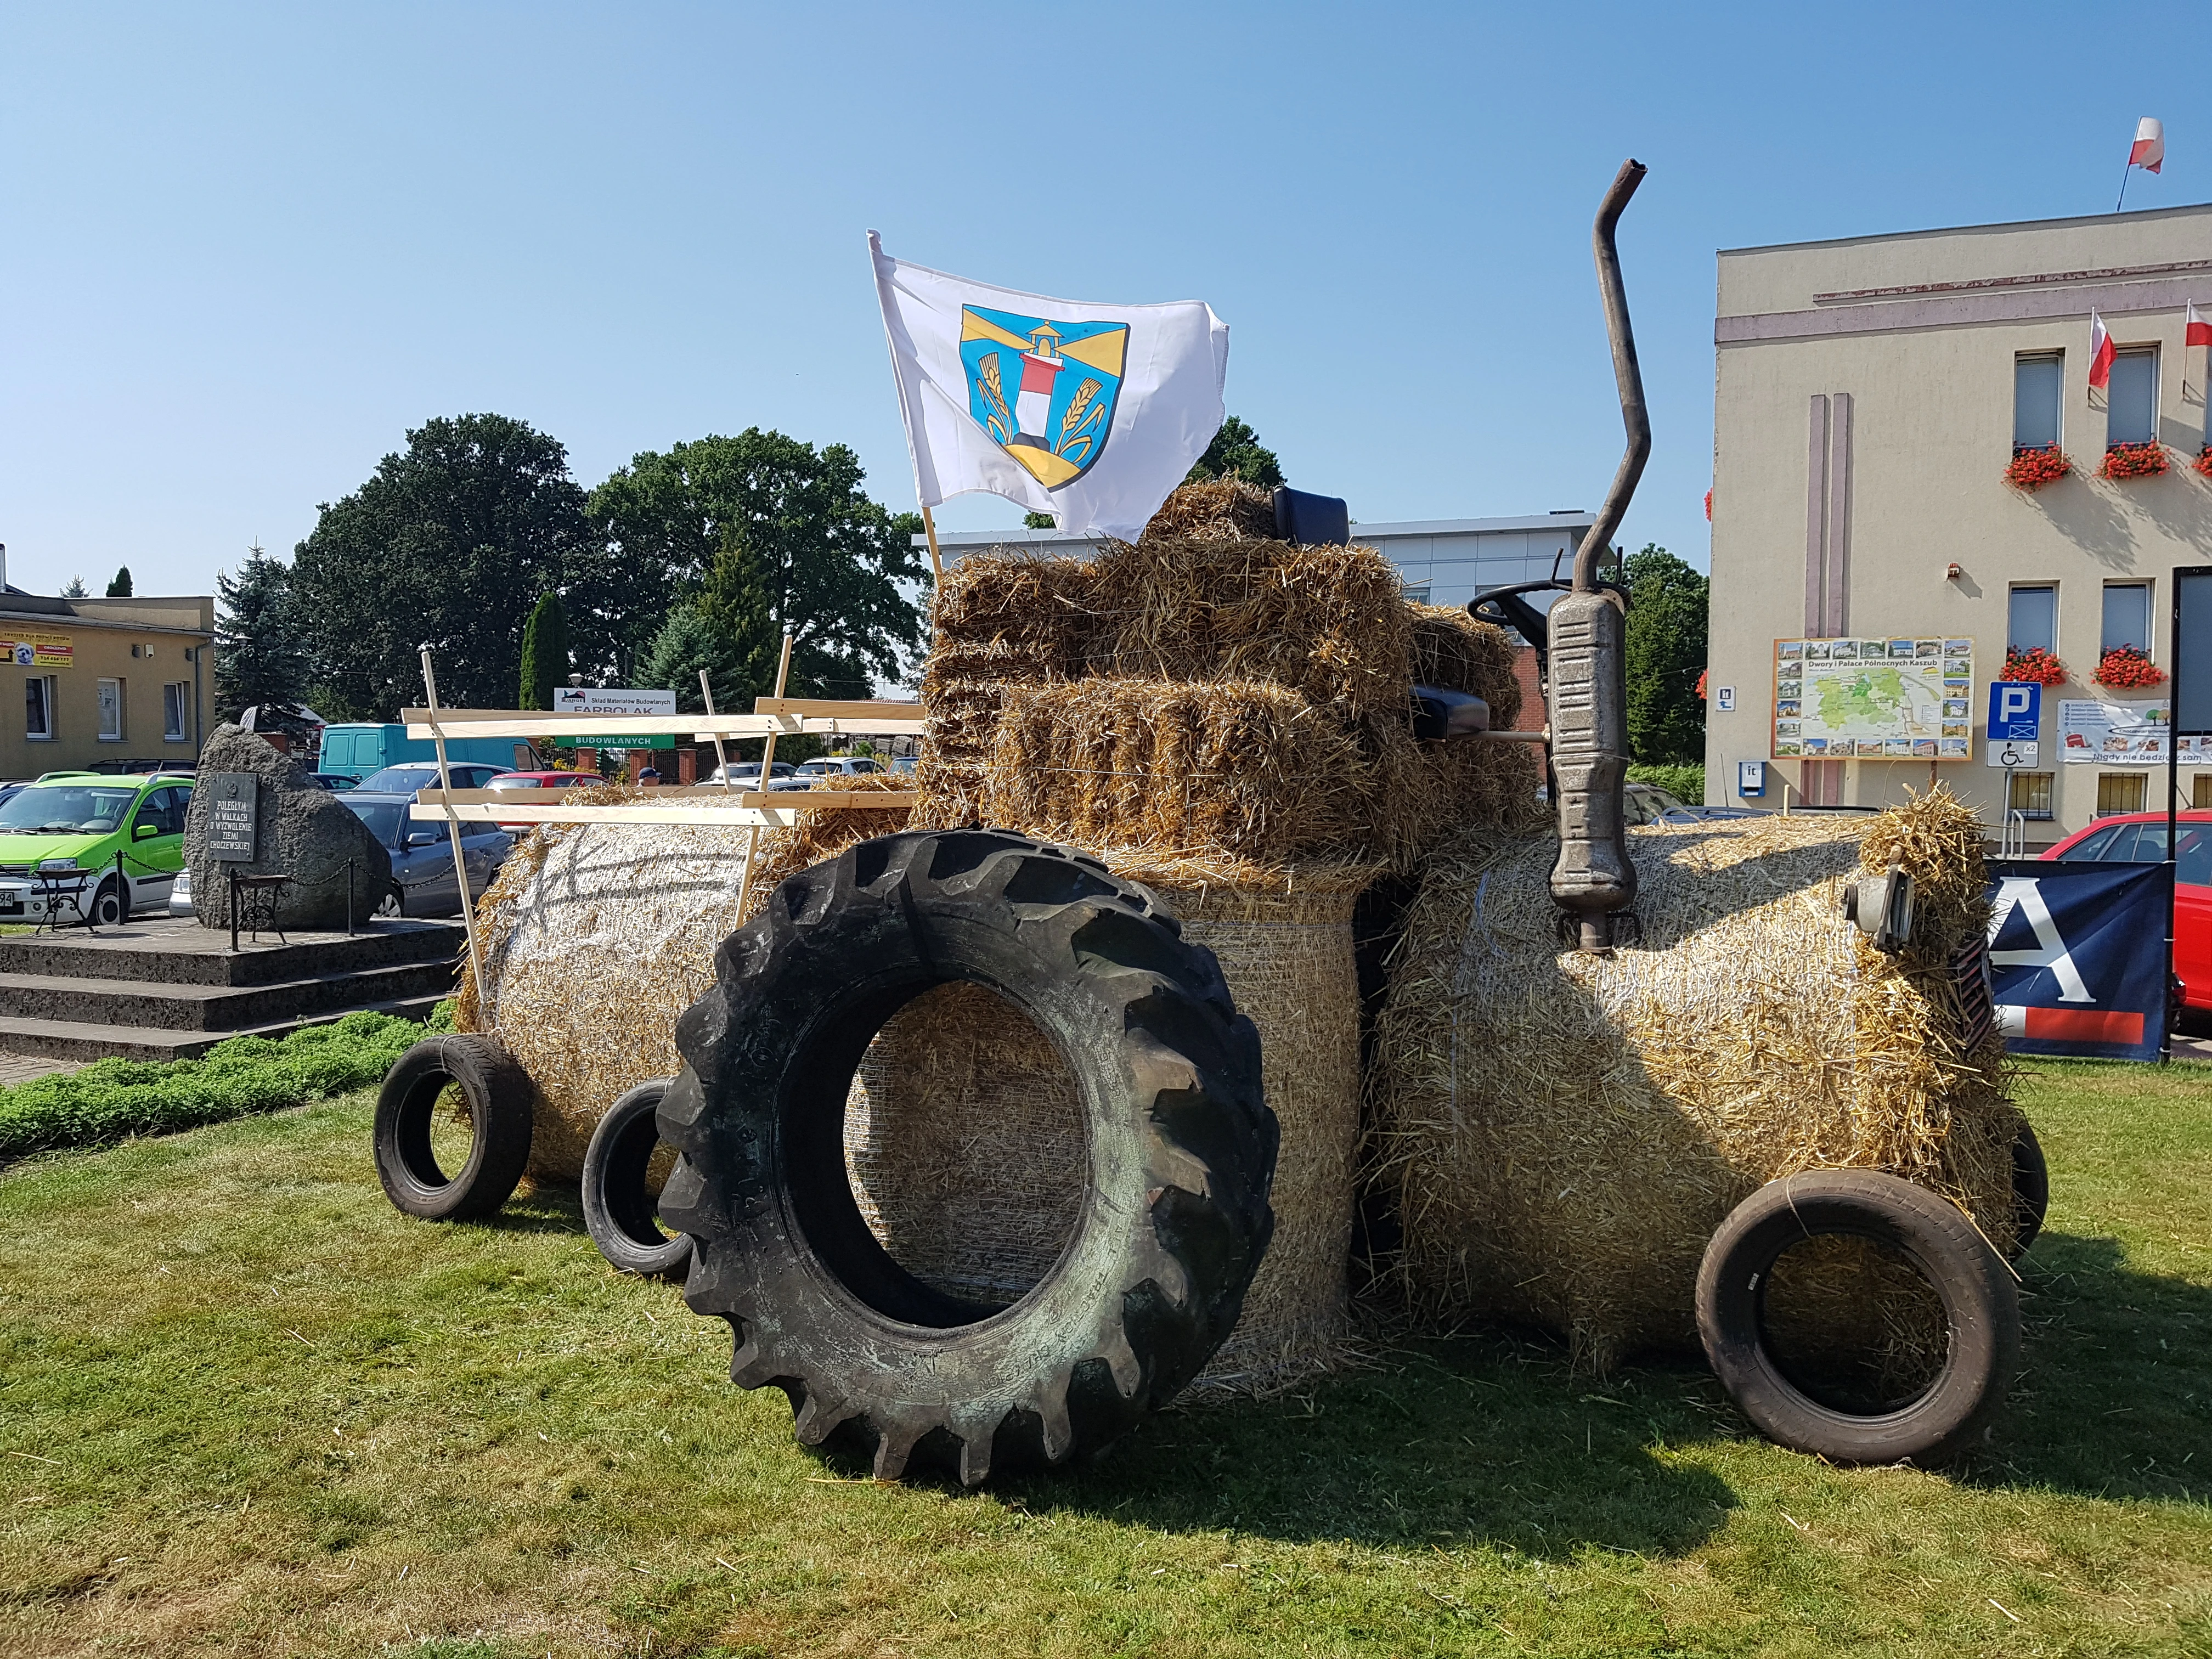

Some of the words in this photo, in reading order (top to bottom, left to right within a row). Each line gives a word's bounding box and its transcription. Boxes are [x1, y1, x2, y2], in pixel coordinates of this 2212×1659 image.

[1864, 659, 1908, 668] Północnych
[2000, 687, 2030, 723] P
[575, 736, 651, 745] BUDOWLANYCH
[2093, 753, 2120, 761] Nigdy
[1747, 765, 1757, 776] it
[217, 800, 246, 811] POLEGŁYM
[215, 812, 221, 820] W
[222, 812, 248, 821] WALKACH
[210, 821, 214, 830] O
[216, 822, 252, 831] WYZWOLENIE
[222, 831, 239, 840] ZIEMI
[210, 840, 250, 851] CHOCZEWSKIEJ
